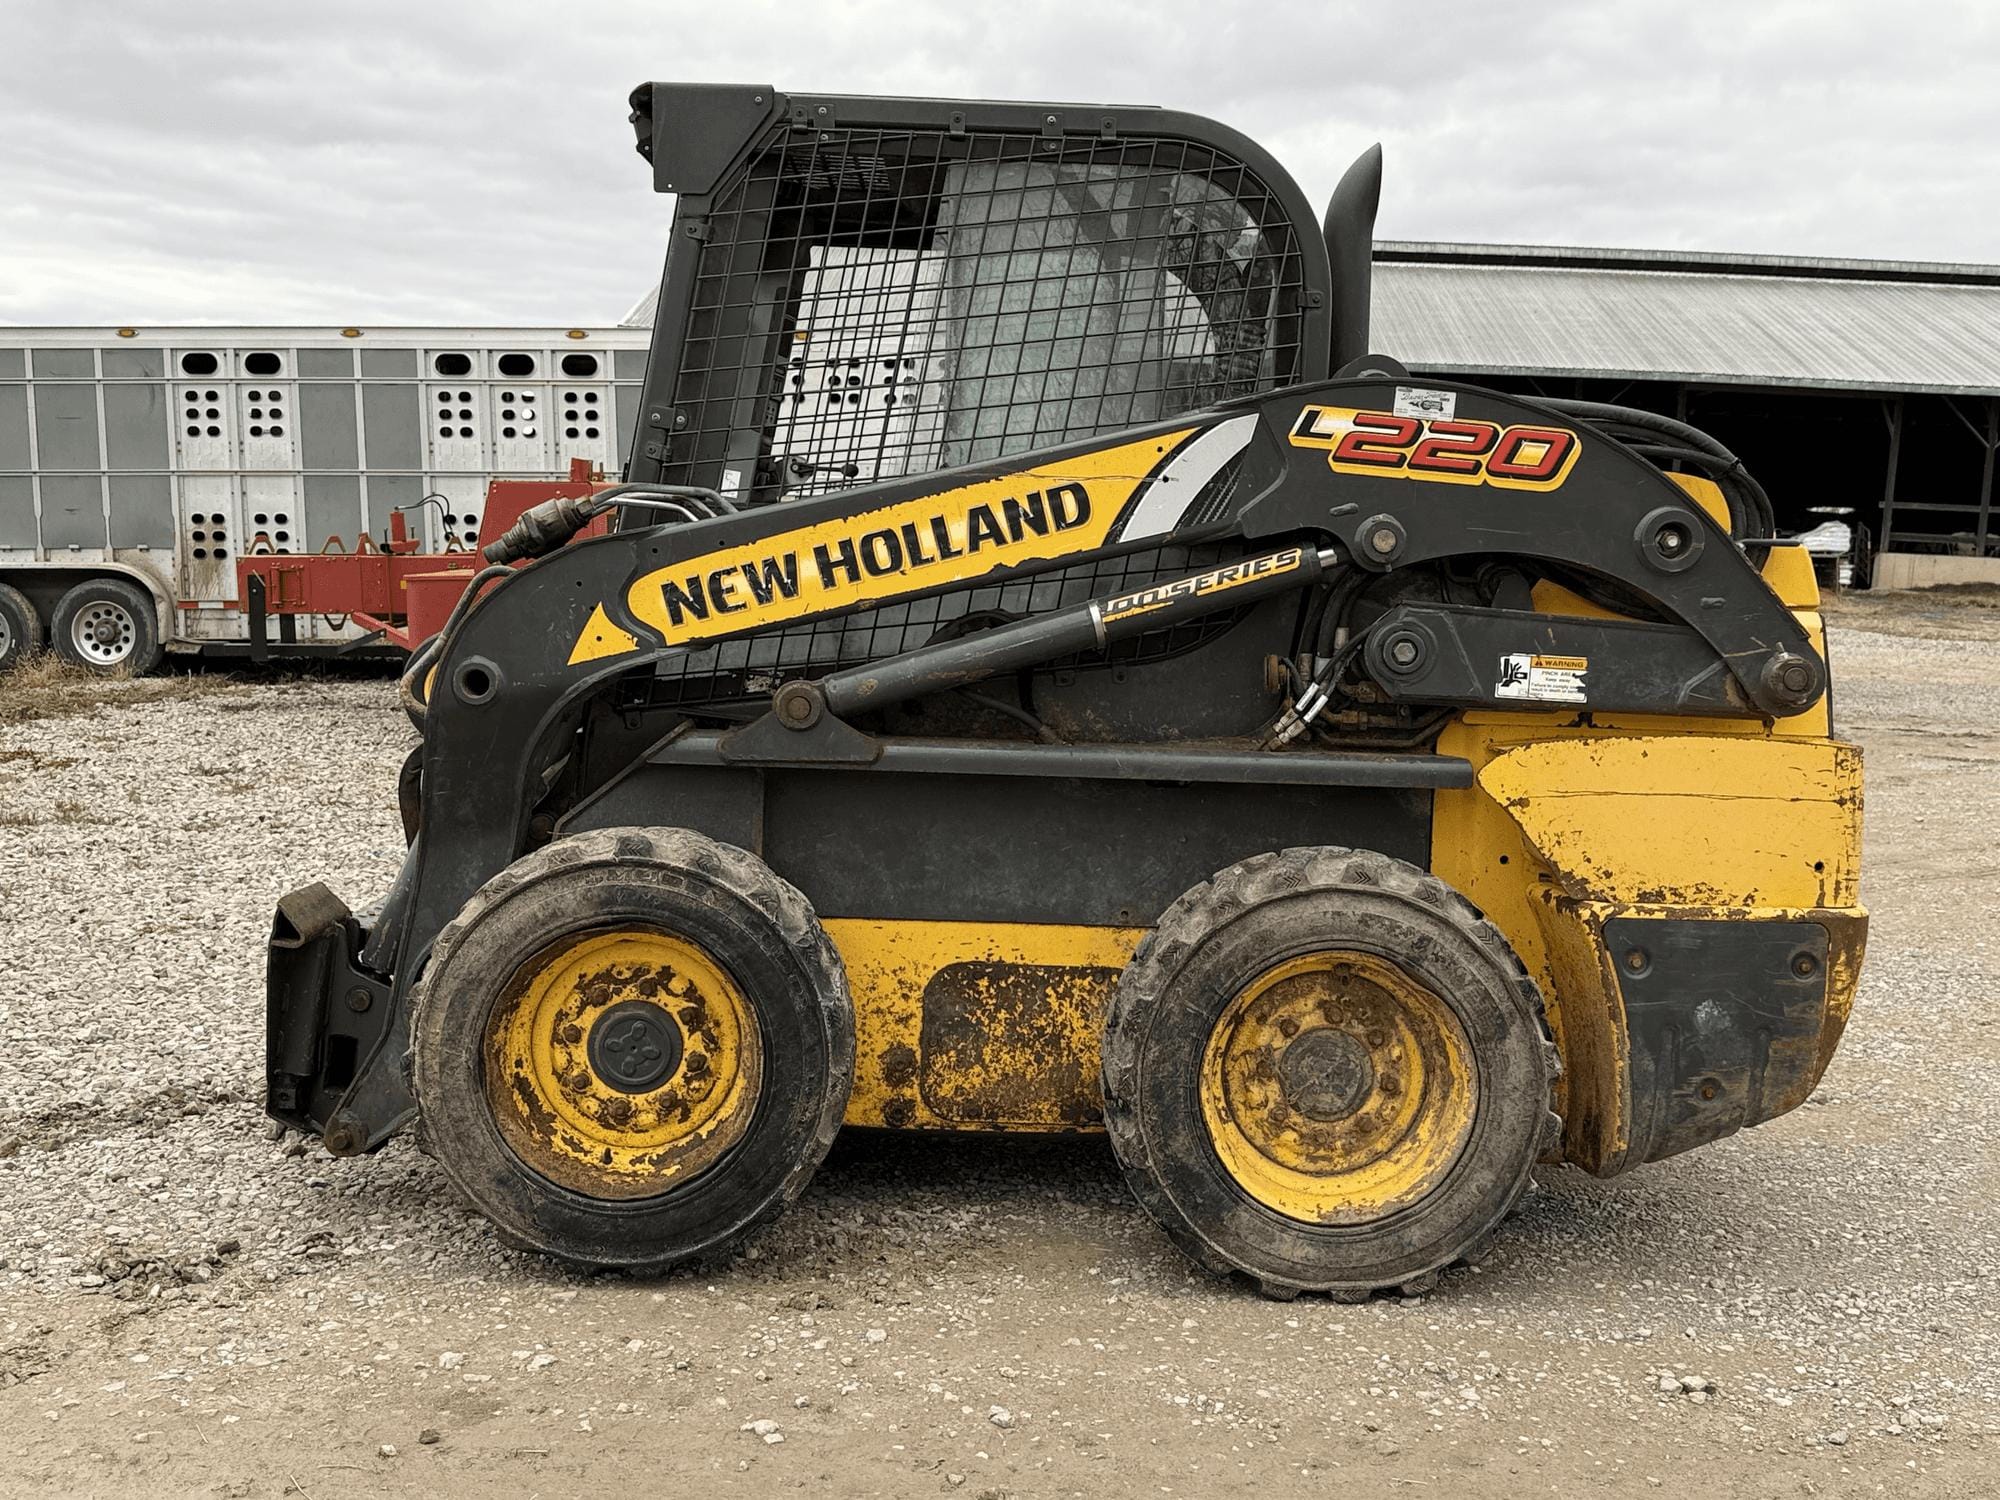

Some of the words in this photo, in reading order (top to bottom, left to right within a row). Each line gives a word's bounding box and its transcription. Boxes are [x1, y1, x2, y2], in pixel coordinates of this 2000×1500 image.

[1289, 408, 1577, 483] L220
[660, 551, 800, 628] NEW
[812, 482, 1092, 591] HOLLAND
[1545, 660, 1584, 668] WARNING
